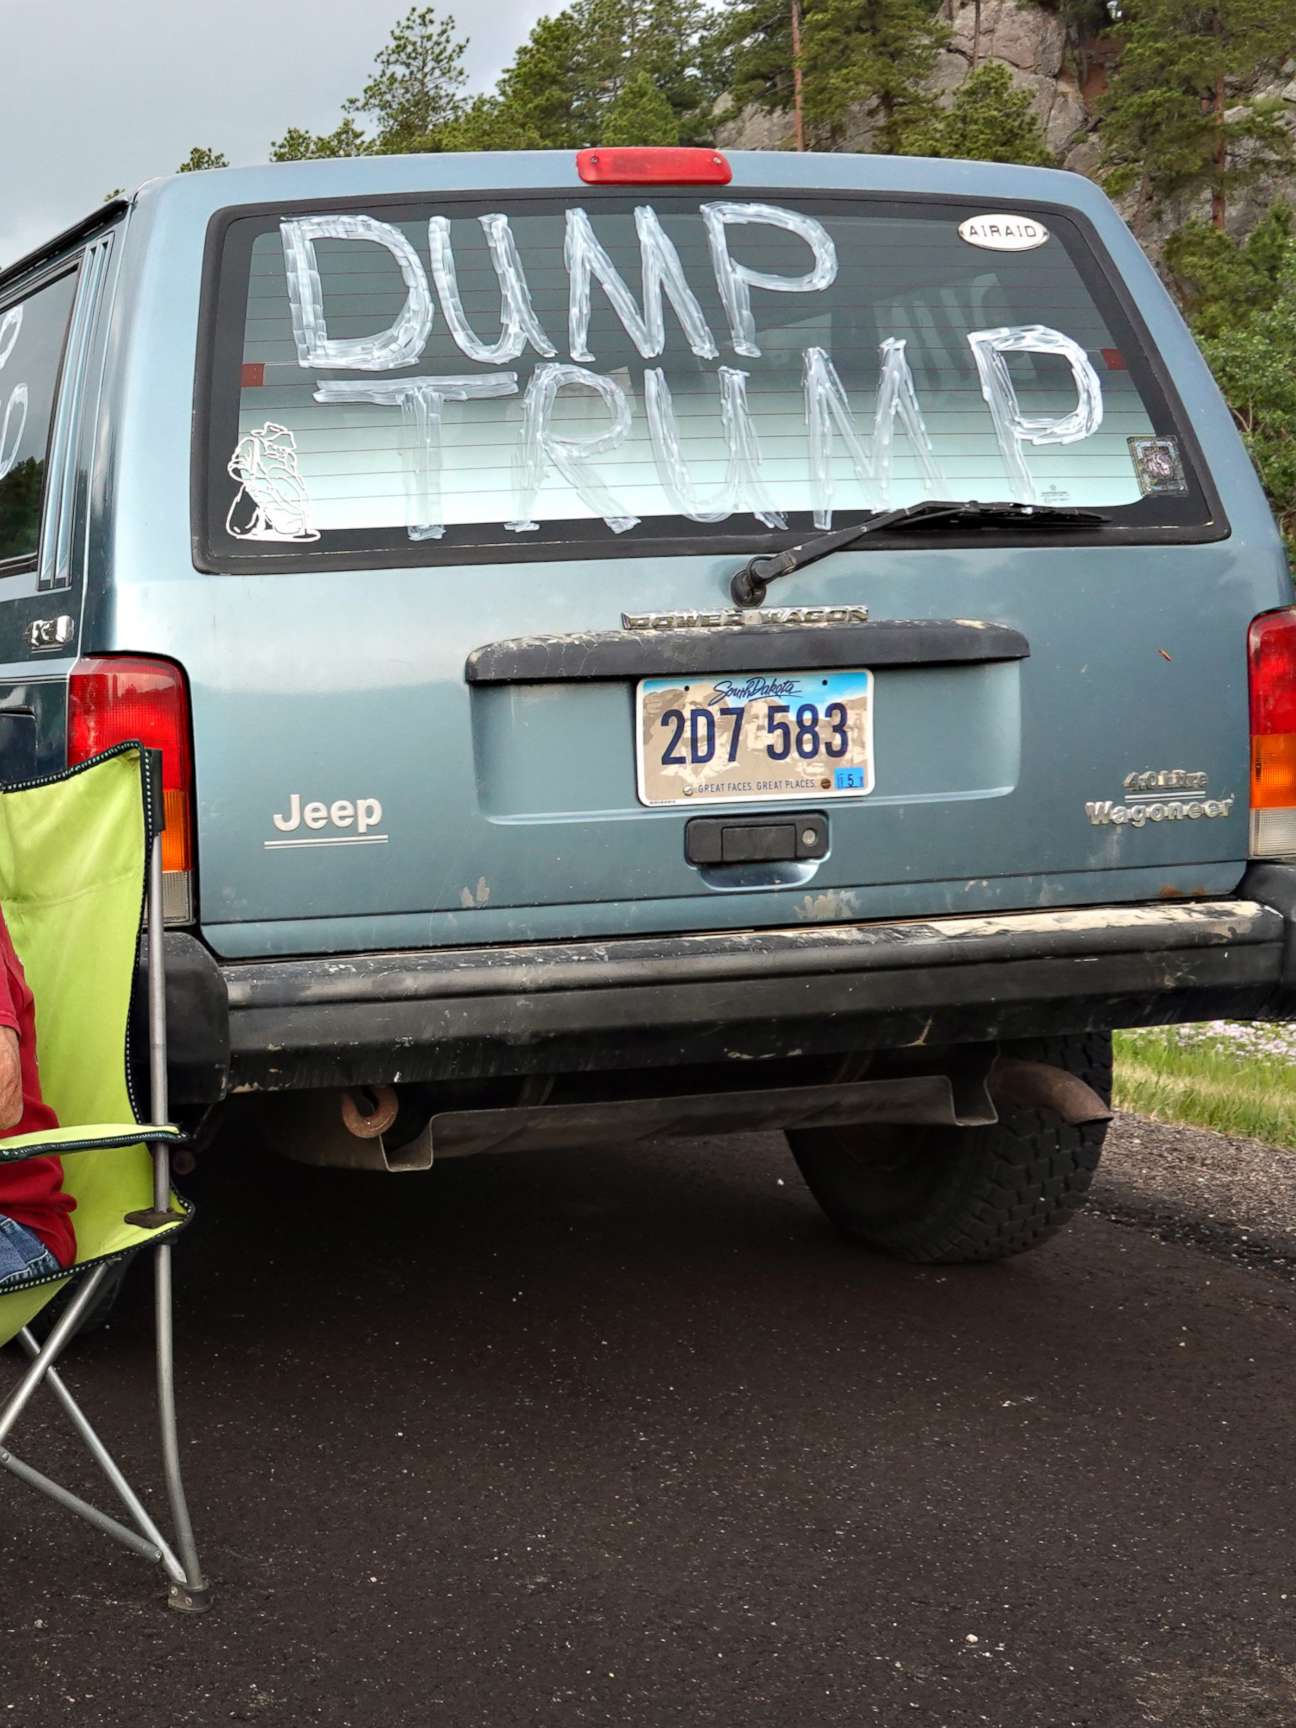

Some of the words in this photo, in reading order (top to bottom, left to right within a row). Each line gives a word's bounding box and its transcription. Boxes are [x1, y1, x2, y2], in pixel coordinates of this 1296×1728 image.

[969, 224, 1037, 238] AIRAID
[279, 201, 838, 368] DUMP
[313, 324, 1103, 541] TRUMP
[708, 680, 754, 706] South
[746, 676, 801, 699] Dakota
[660, 706, 745, 766] 2D7
[766, 702, 849, 761] 583
[698, 782, 724, 793] GREAT
[756, 780, 783, 791] GREAT
[272, 794, 383, 833] Jeep
[1084, 800, 1232, 828] Wagoneer
